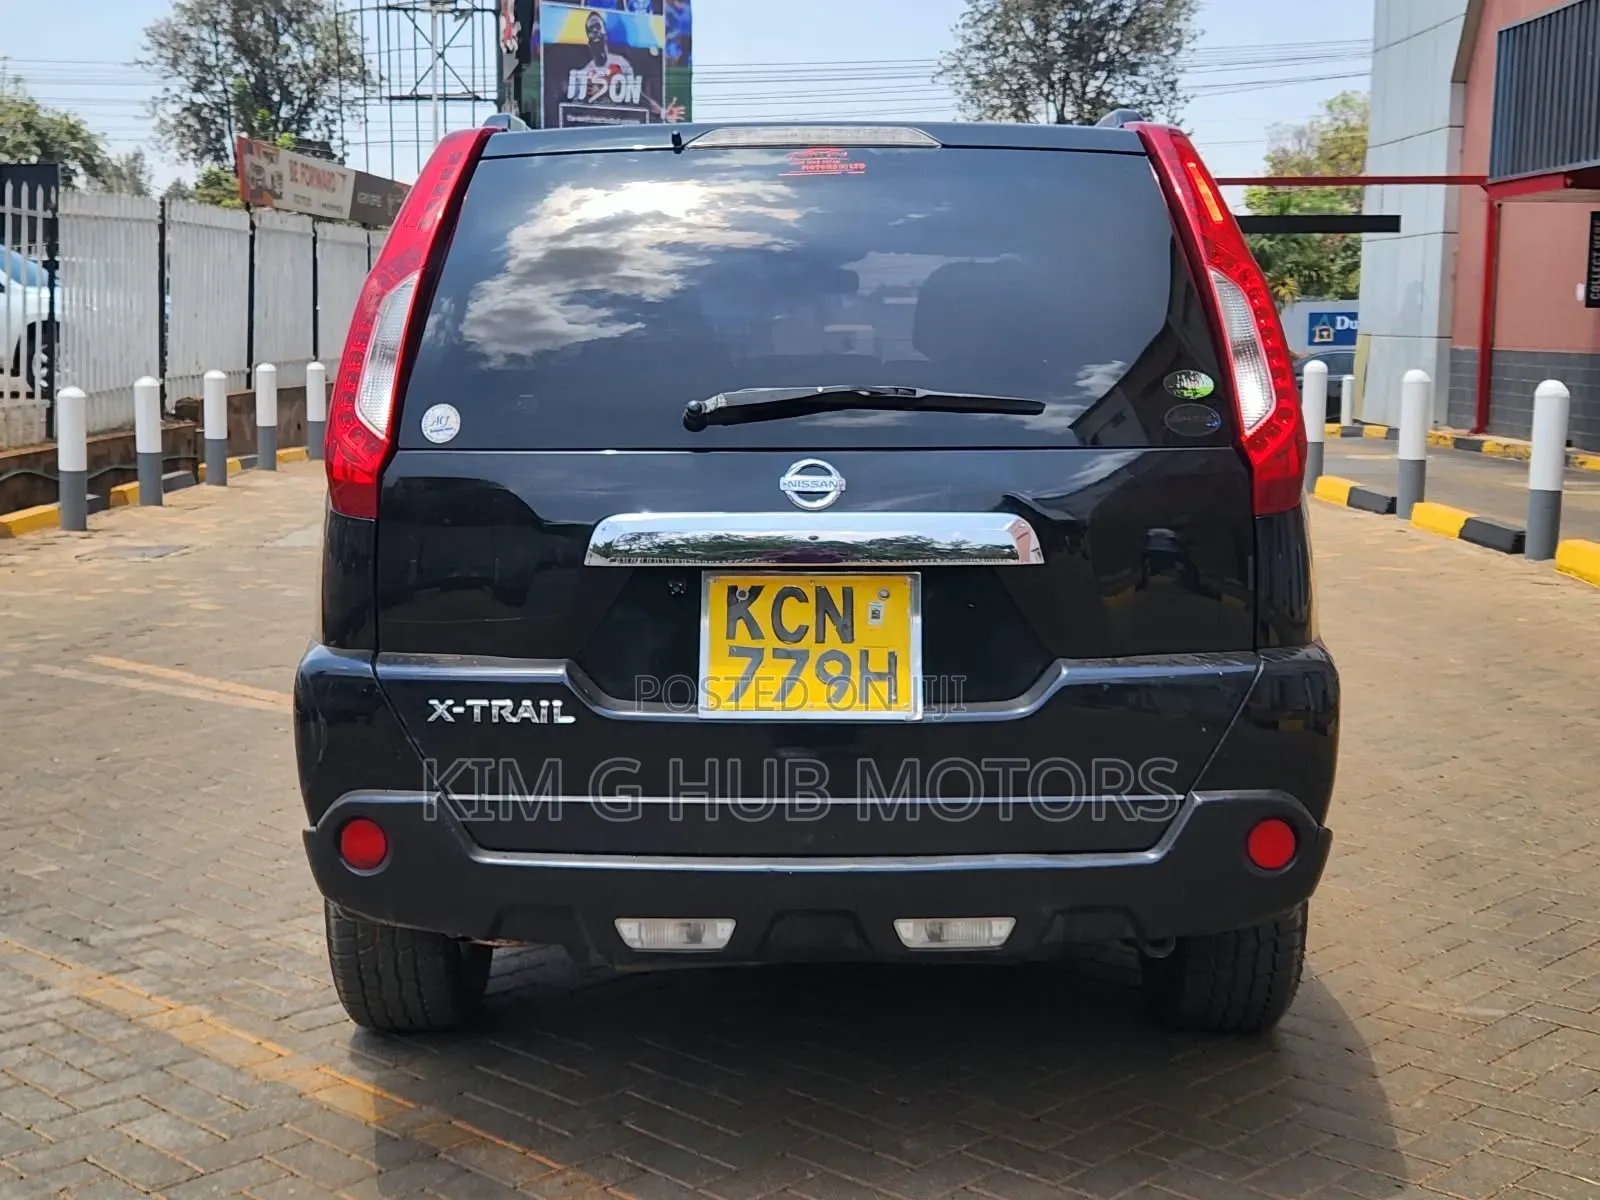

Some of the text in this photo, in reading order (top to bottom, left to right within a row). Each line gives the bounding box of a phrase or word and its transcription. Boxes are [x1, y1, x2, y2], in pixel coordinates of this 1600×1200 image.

[610, 72, 643, 104] ON
[787, 479, 838, 489] NISSAN
[725, 584, 855, 644] KCN
[726, 645, 898, 705] 779H
[426, 698, 577, 724] X-TRAIL
